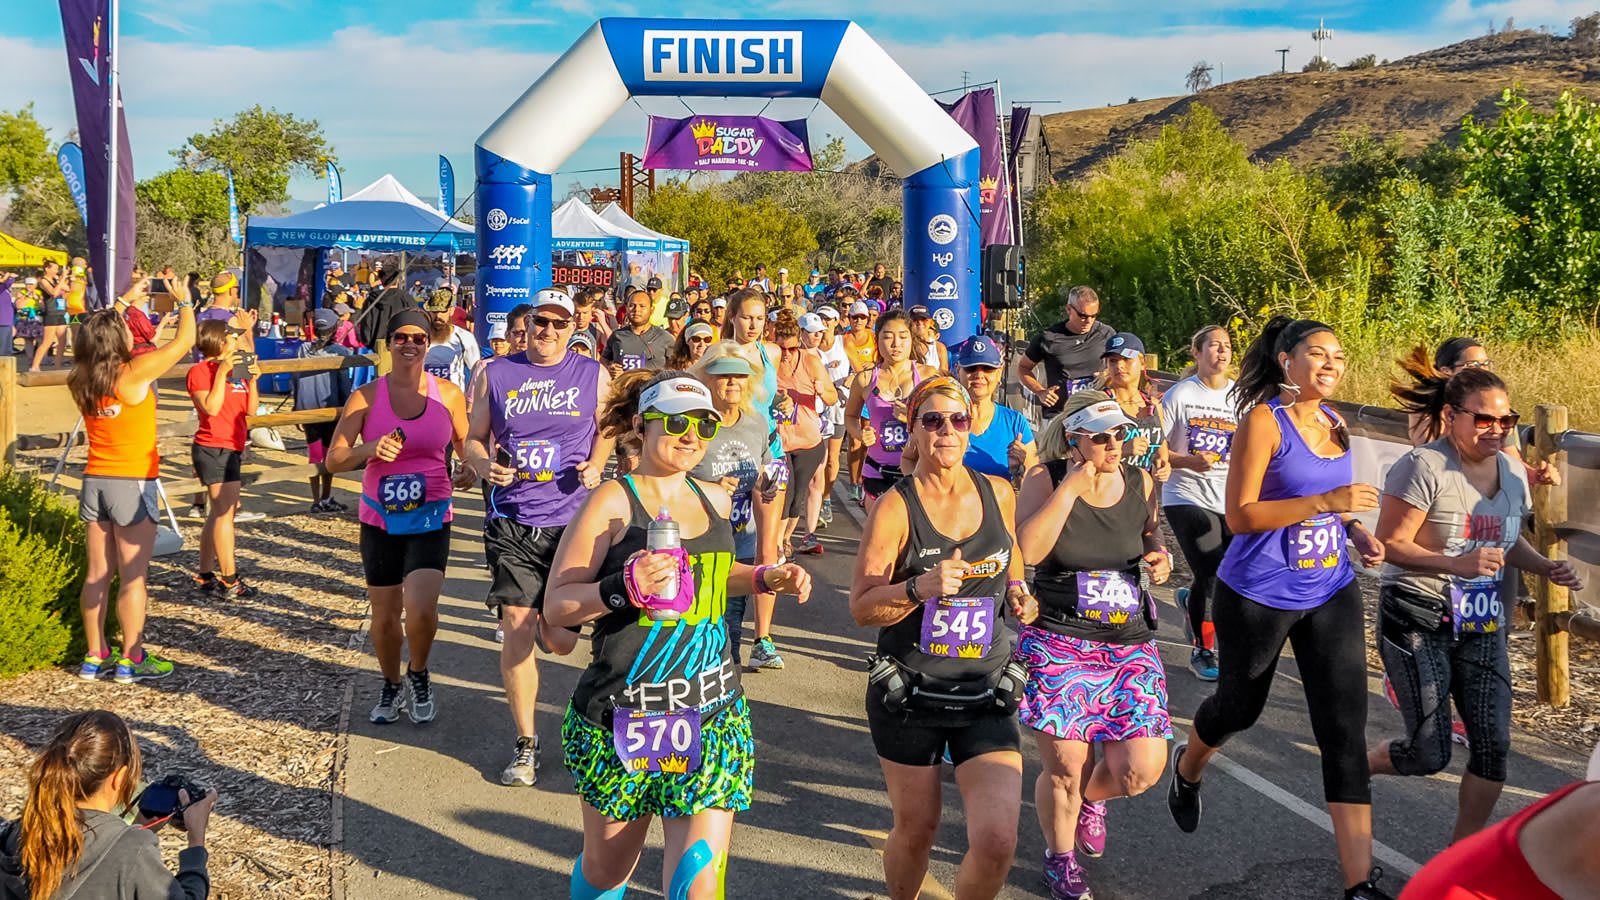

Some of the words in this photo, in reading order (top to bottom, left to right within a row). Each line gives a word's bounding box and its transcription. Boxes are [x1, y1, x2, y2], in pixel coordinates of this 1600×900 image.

[652, 37, 793, 74] FINISH
[715, 127, 755, 138] SUGAR
[696, 136, 764, 157] DADDY
[282, 231, 306, 240] NEW
[309, 232, 351, 241] GLOBAL
[355, 234, 427, 246] ADVENTURES
[556, 240, 605, 248] ADVENTURES
[622, 358, 641, 370] 551
[505, 387, 580, 420] RUNNER
[1194, 432, 1227, 453] 599
[516, 447, 554, 470] 567
[384, 481, 422, 501] 568
[1298, 525, 1338, 555] 591
[1298, 559, 1315, 568] 10K
[1085, 610, 1102, 619] 10K
[1460, 592, 1500, 618] 606
[932, 610, 987, 640] 545
[929, 642, 950, 655] 10K
[640, 658, 733, 711] FREE
[626, 718, 693, 753] 570
[629, 757, 659, 771] 10K
